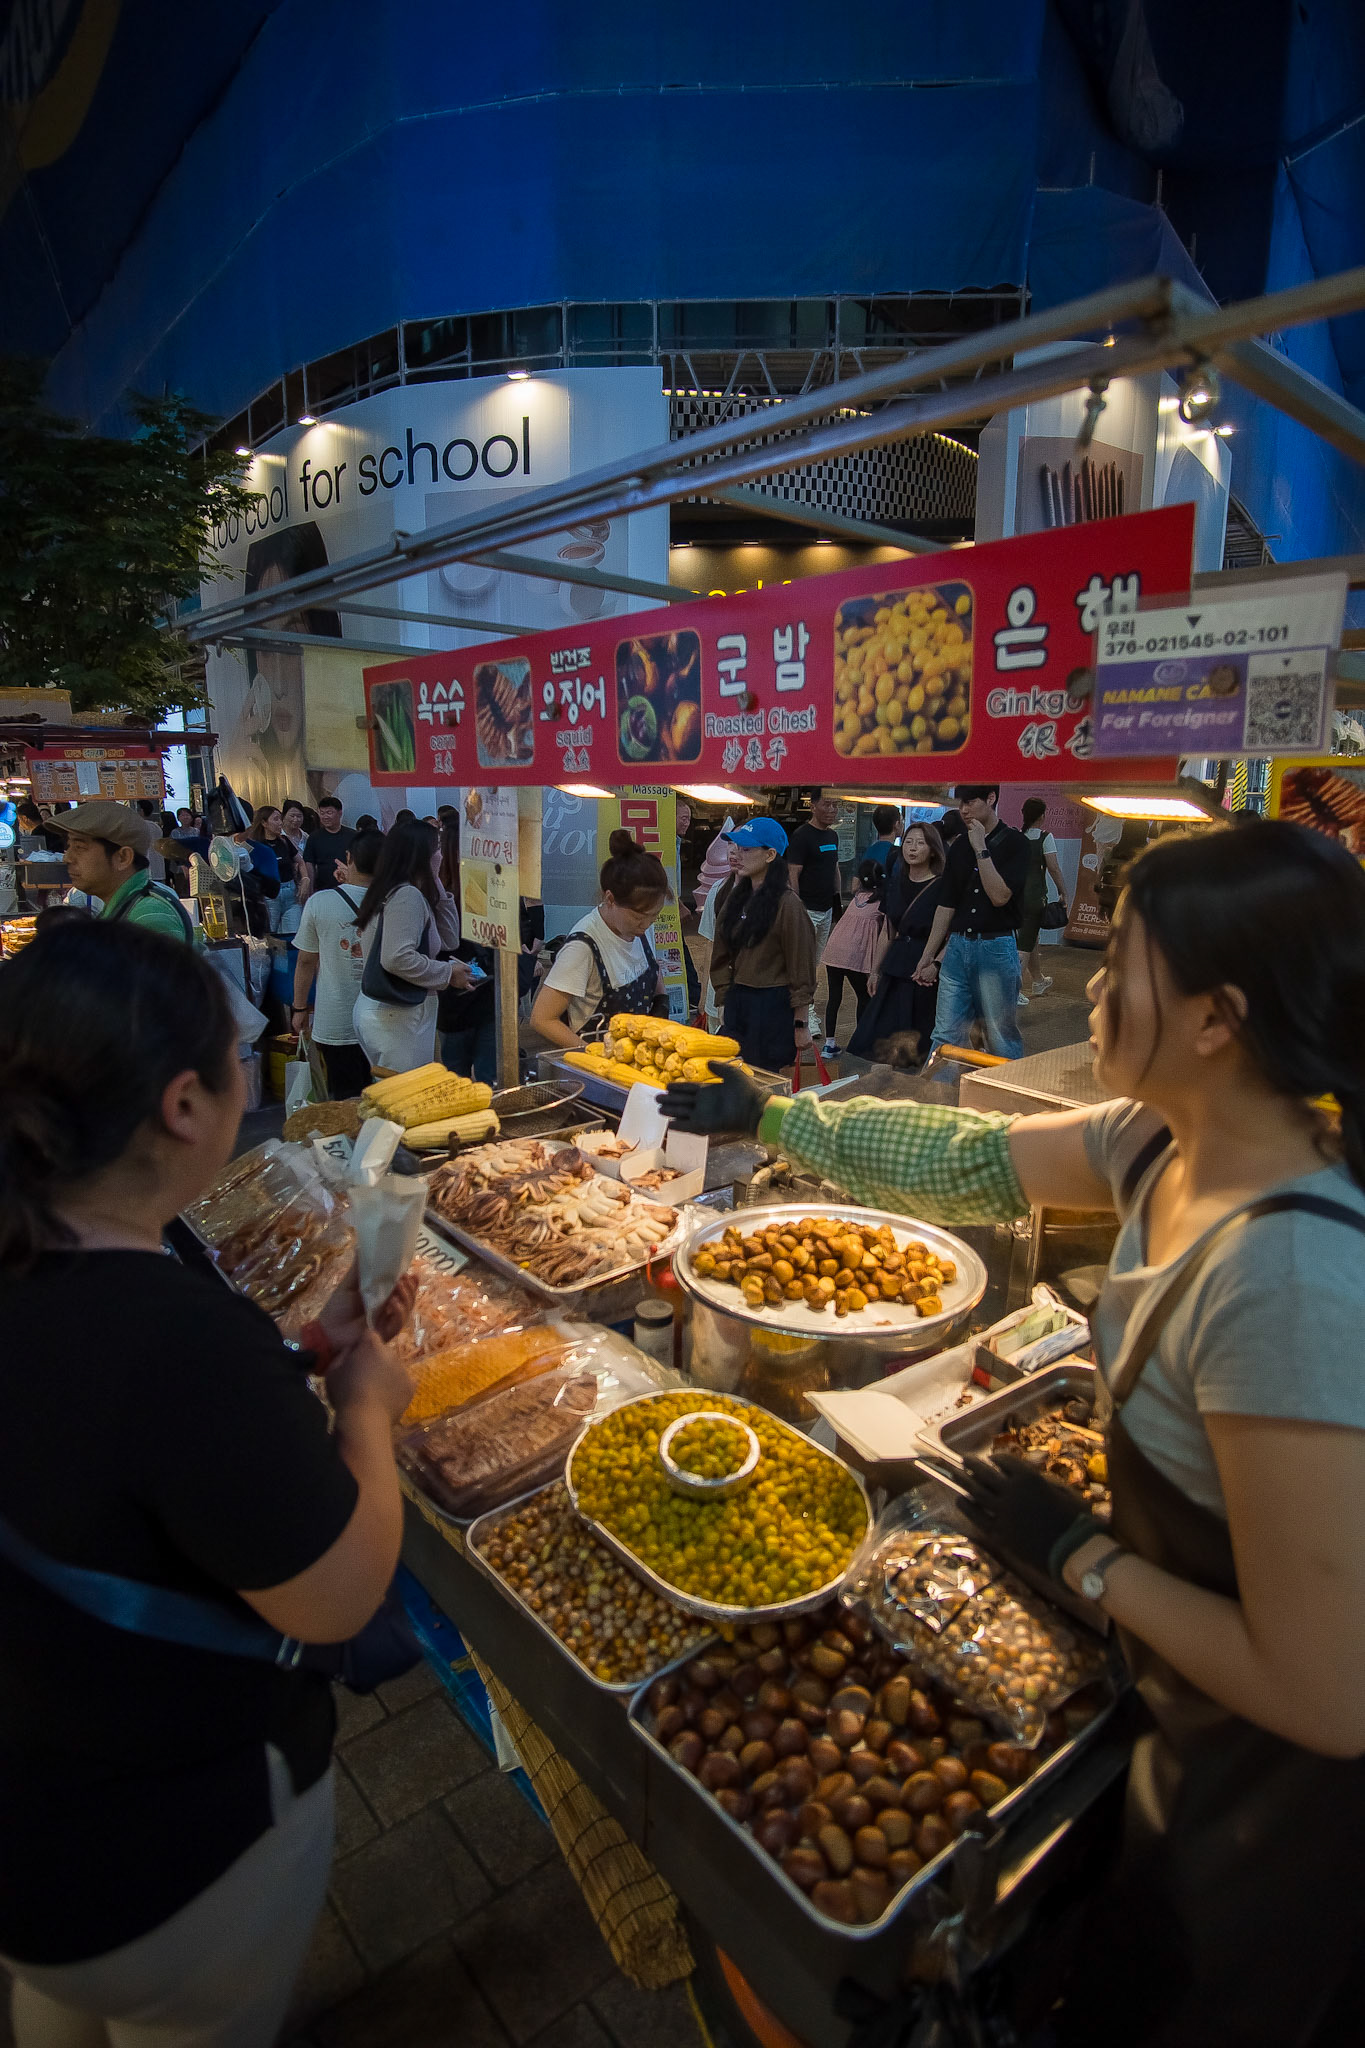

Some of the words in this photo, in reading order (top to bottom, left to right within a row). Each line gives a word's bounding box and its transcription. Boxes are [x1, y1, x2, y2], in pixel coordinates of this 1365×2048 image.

[299, 459, 347, 512] for
[358, 416, 531, 496] school
[1105, 625, 1290, 657] 376-021545-02-101
[1106, 619, 1136, 639] 우리
[550, 647, 592, 674] 반건조
[417, 679, 465, 726] 옥수수
[540, 676, 606, 725] 오징어
[705, 709, 765, 738] Roasted
[767, 704, 817, 735] Chest
[1101, 712, 1133, 730] For
[1138, 708, 1238, 730] Foreigner
[556, 725, 593, 752] squid
[632, 784, 674, 798] Massage
[489, 896, 508, 910] Corn
